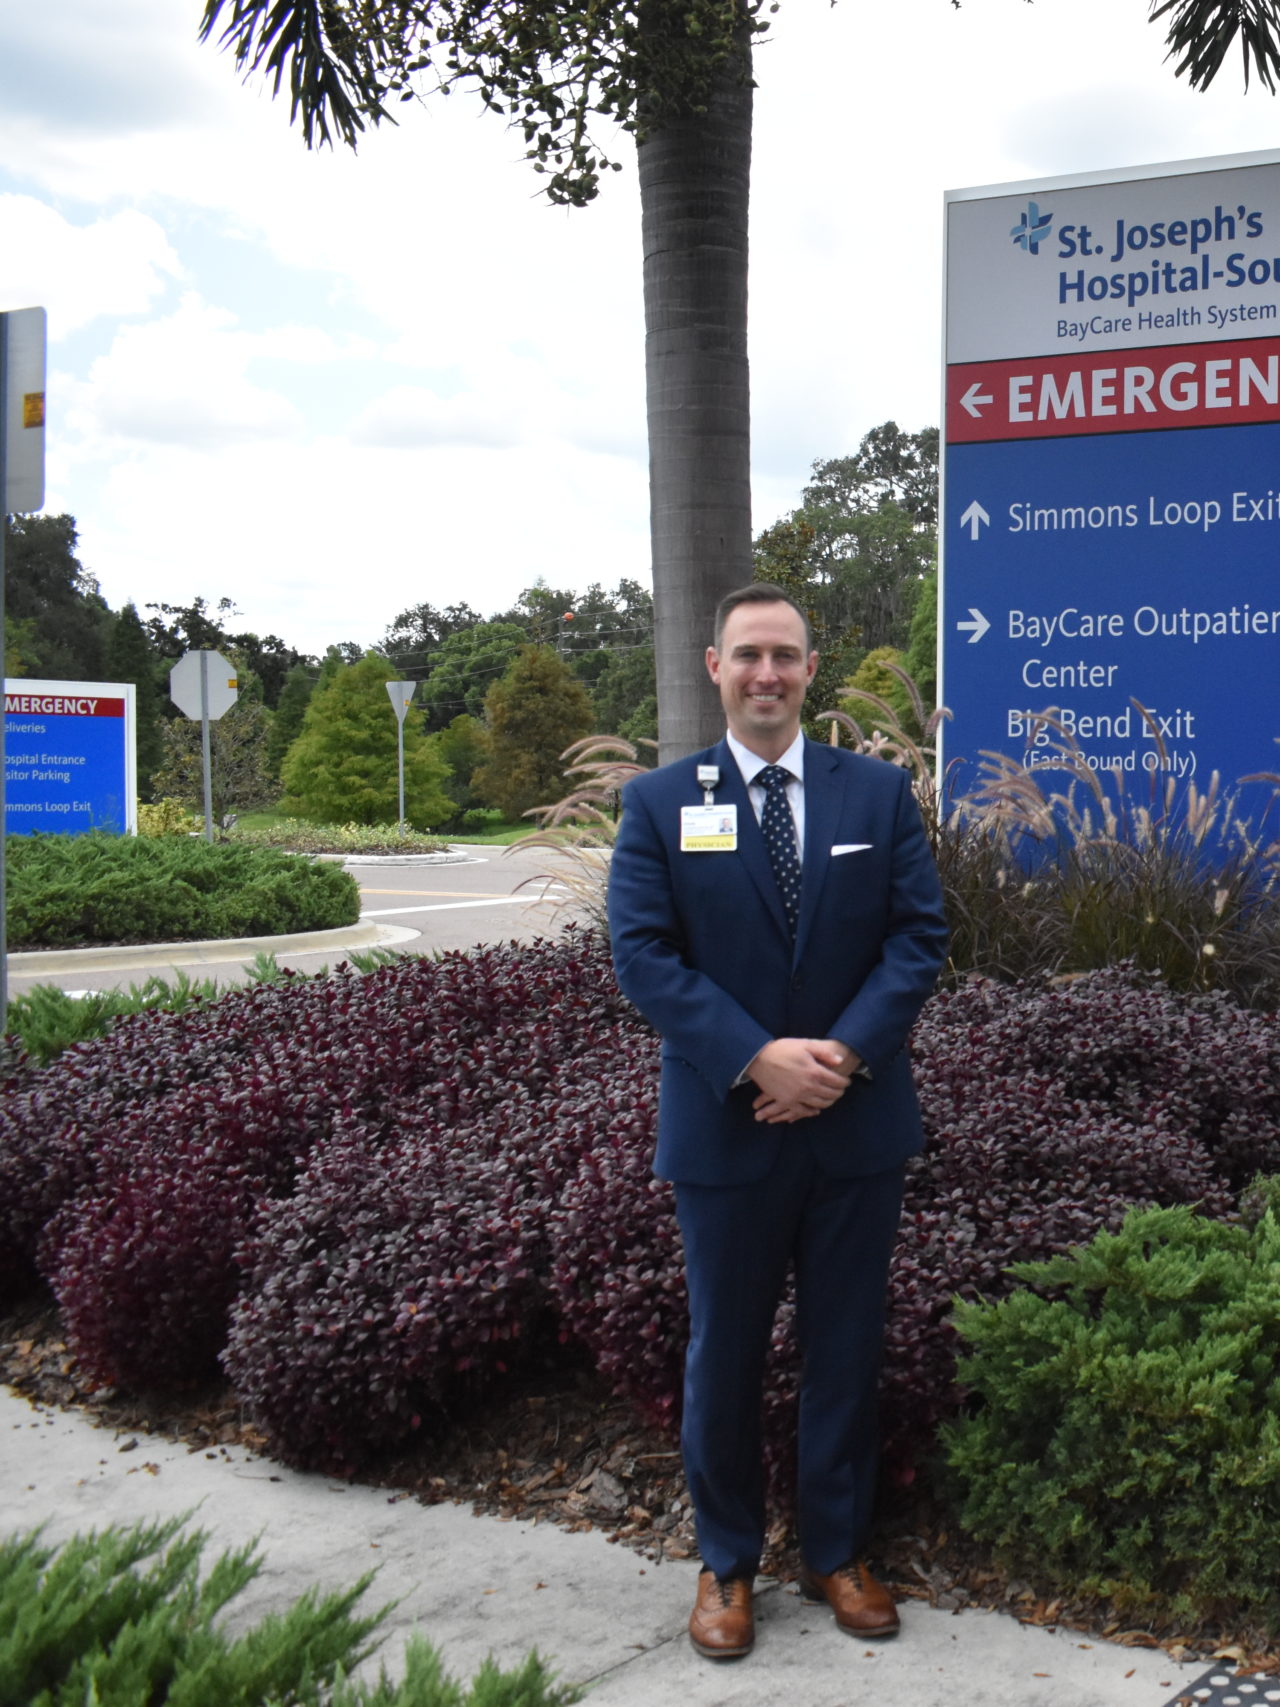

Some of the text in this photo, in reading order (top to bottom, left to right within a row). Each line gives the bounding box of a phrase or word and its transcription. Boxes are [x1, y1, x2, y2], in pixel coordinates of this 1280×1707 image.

[1057, 224, 1104, 259] St.
[1056, 300, 1277, 341] BayCare Health System
[1007, 501, 1139, 533] Simmons
[1148, 496, 1221, 533] Loop
[1007, 608, 1124, 647] BayCare
[1021, 658, 1119, 690] Center
[4, 696, 98, 715] MERGENCY
[5, 722, 46, 734] eliveries
[1007, 706, 1196, 747] Big Bend Exit
[5, 754, 86, 766] ospital Entrance
[1142, 750, 1197, 778] Only)
[6, 769, 71, 784] sitor Parking
[45, 801, 71, 814] Loop
[73, 800, 91, 812] Exit
